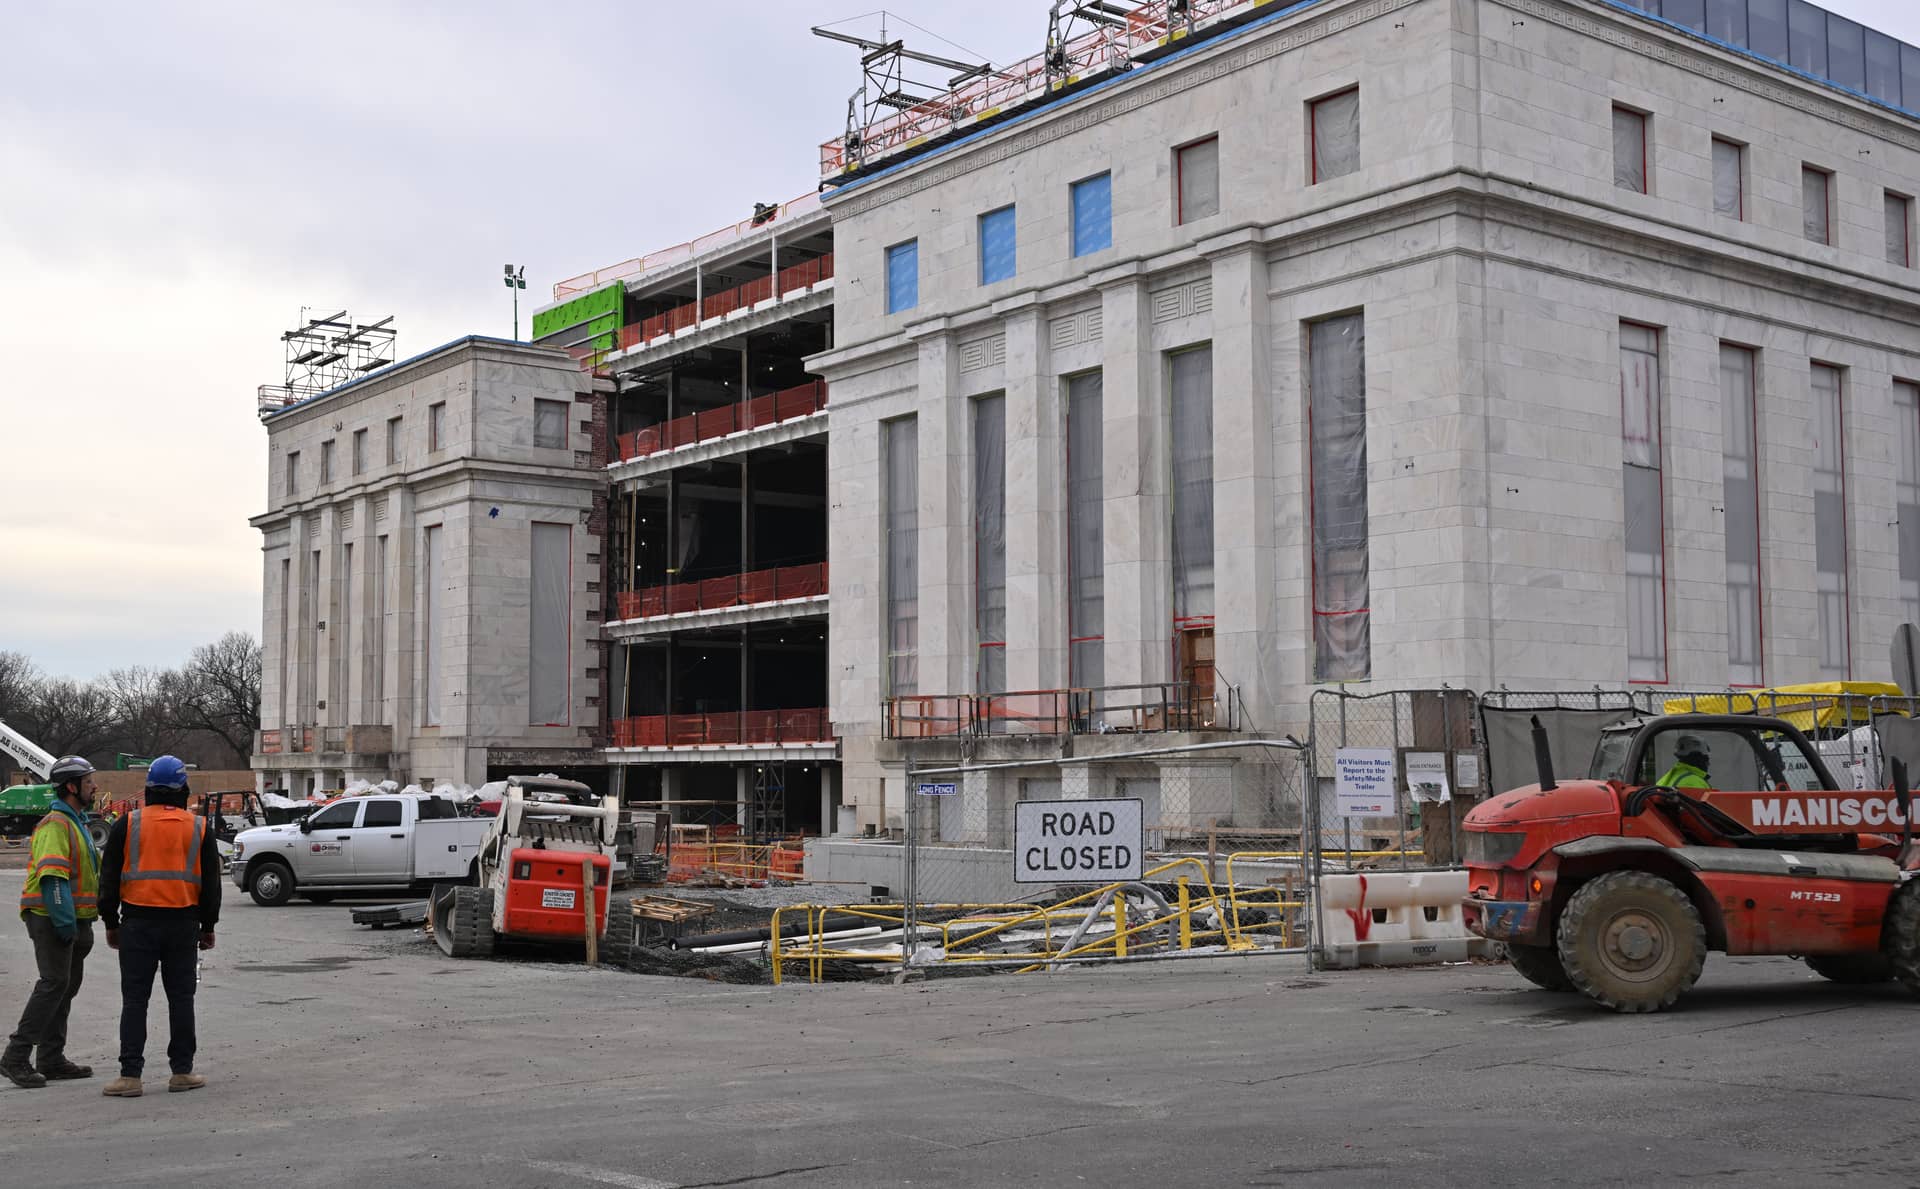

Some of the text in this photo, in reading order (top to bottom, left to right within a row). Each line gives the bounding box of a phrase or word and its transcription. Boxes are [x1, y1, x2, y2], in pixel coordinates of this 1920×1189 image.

[11, 742, 30, 760] ULTRA
[1343, 767, 1365, 775] Report
[1343, 775, 1385, 783] Safety/Medic
[934, 784, 954, 794] FENCE
[1355, 783, 1375, 791] Trailer
[1752, 798, 1920, 826] MANISCO
[1041, 812, 1115, 836] ROAD
[1026, 845, 1131, 871] CLOSED
[1790, 891, 1841, 902] MT523
